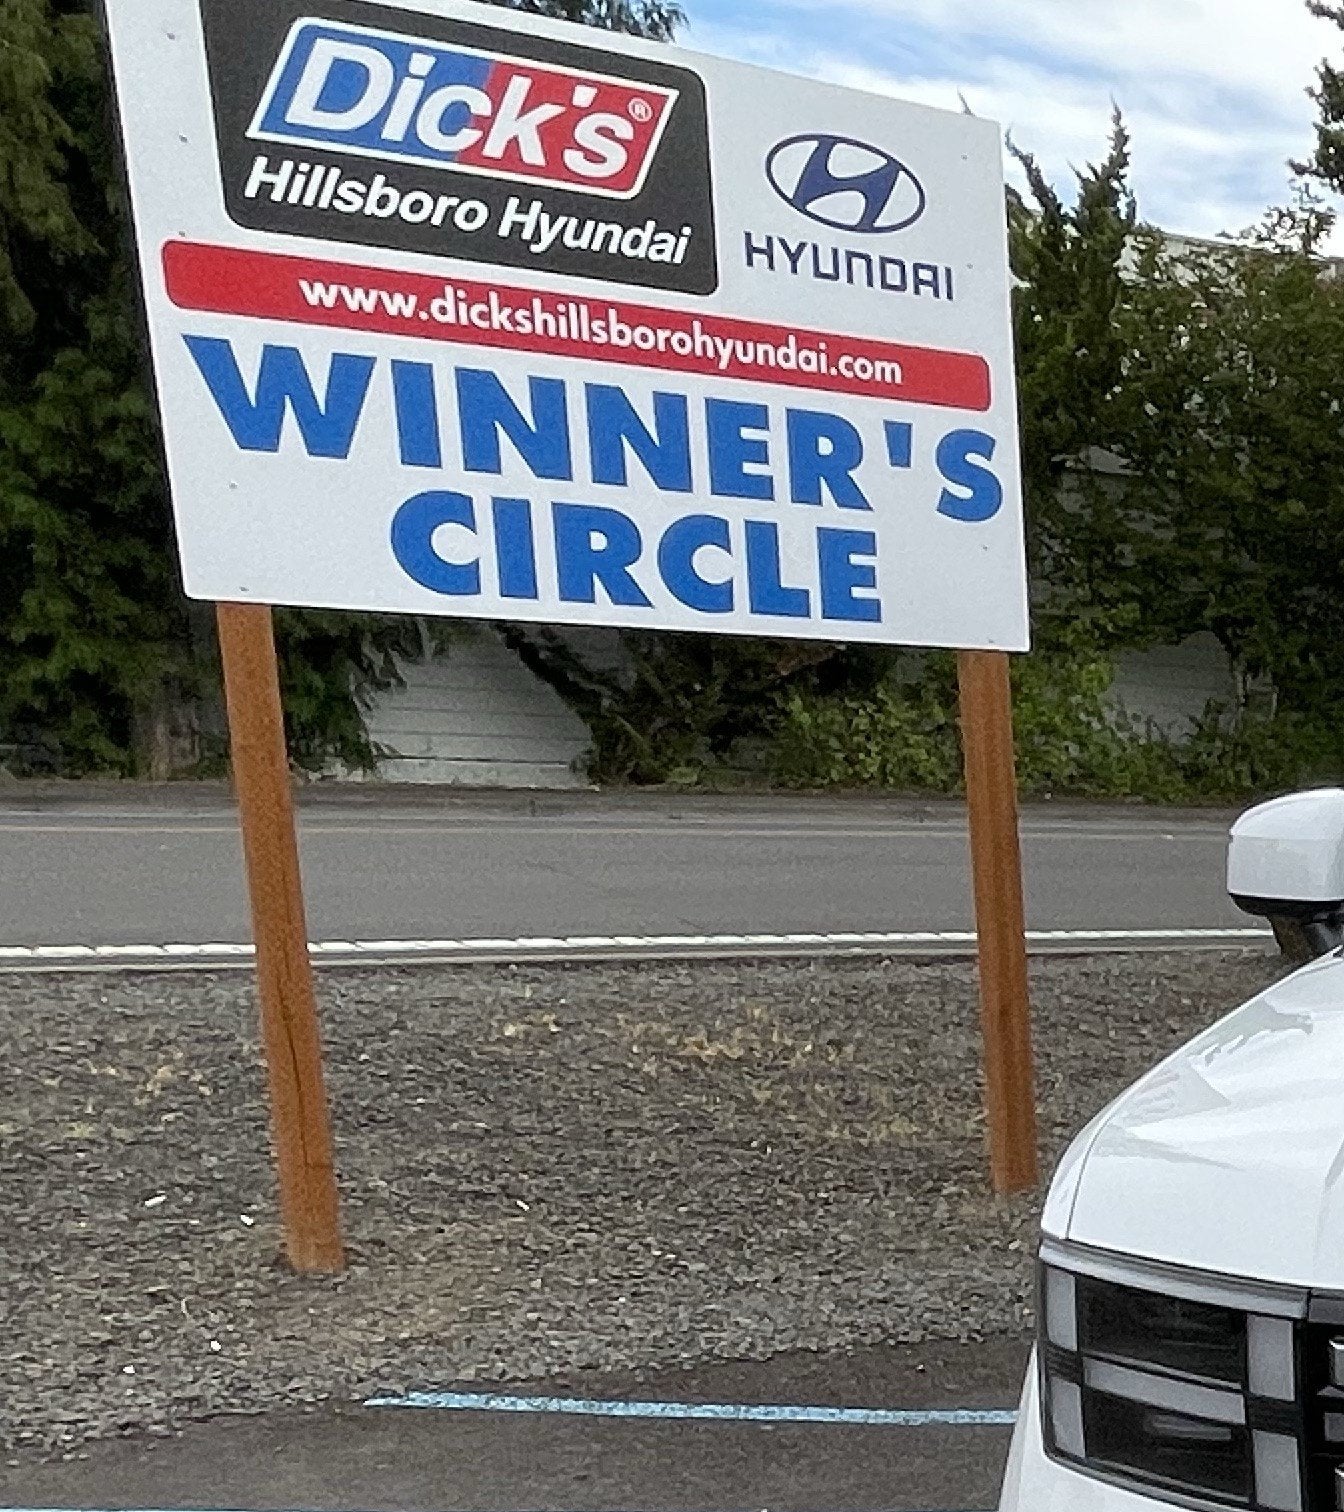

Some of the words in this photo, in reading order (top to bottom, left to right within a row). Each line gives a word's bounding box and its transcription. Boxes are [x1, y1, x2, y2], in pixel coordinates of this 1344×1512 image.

[284, 37, 636, 179] Dick's
[244, 157, 489, 232] Hillsboro
[499, 197, 693, 264] Hyundai
[744, 231, 954, 301] HYUNDAI
[299, 277, 903, 385] www.dickshillsborohyundai.com
[183, 334, 1004, 522] WINNER'S
[390, 490, 883, 623] CIRCLE
